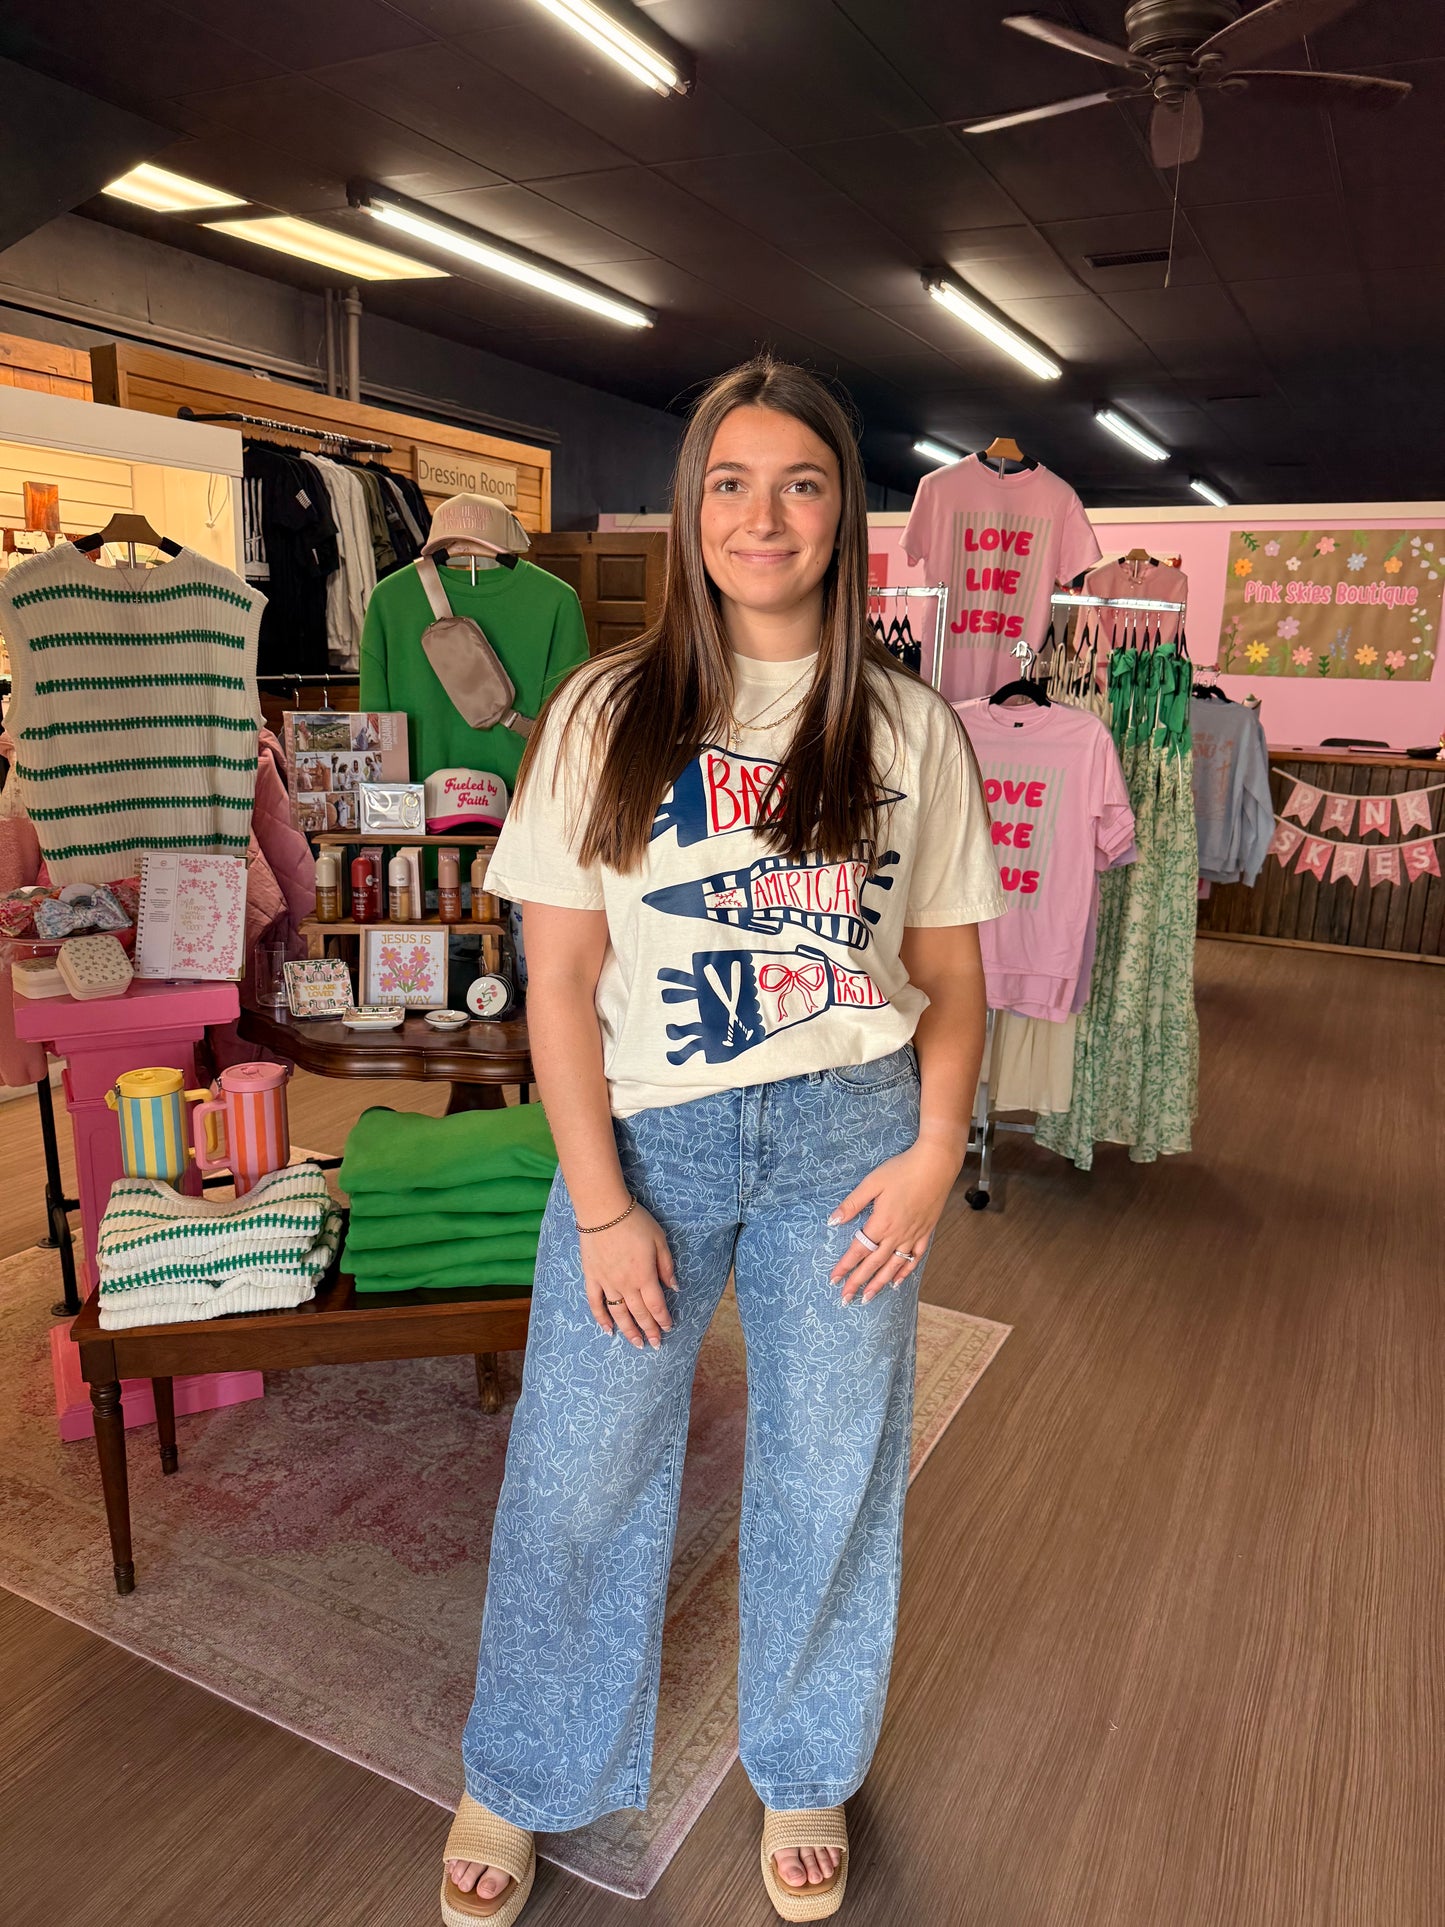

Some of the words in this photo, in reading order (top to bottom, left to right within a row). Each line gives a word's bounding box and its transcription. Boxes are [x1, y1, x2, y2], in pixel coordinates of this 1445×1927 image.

[419, 459, 476, 493] Dressing
[480, 471, 517, 497] Room
[964, 528, 1034, 556] LOVE
[965, 567, 1021, 595] LIKE
[1244, 580, 1282, 603] Pink
[1285, 580, 1332, 604] Skies
[1335, 580, 1419, 610] Boutique
[444, 776, 484, 794] Fueled
[487, 779, 498, 796] by
[457, 791, 489, 808] Faith
[983, 779, 1046, 808] OVE
[1293, 788, 1425, 825] PINK
[991, 821, 1034, 849] KE
[1275, 830, 1430, 876] SKIES
[381, 933, 417, 945] JESUS
[420, 934, 431, 945] IS
[832, 964, 885, 1006] PASTI
[378, 995, 400, 1005] THE
[404, 995, 432, 1005] WAY
